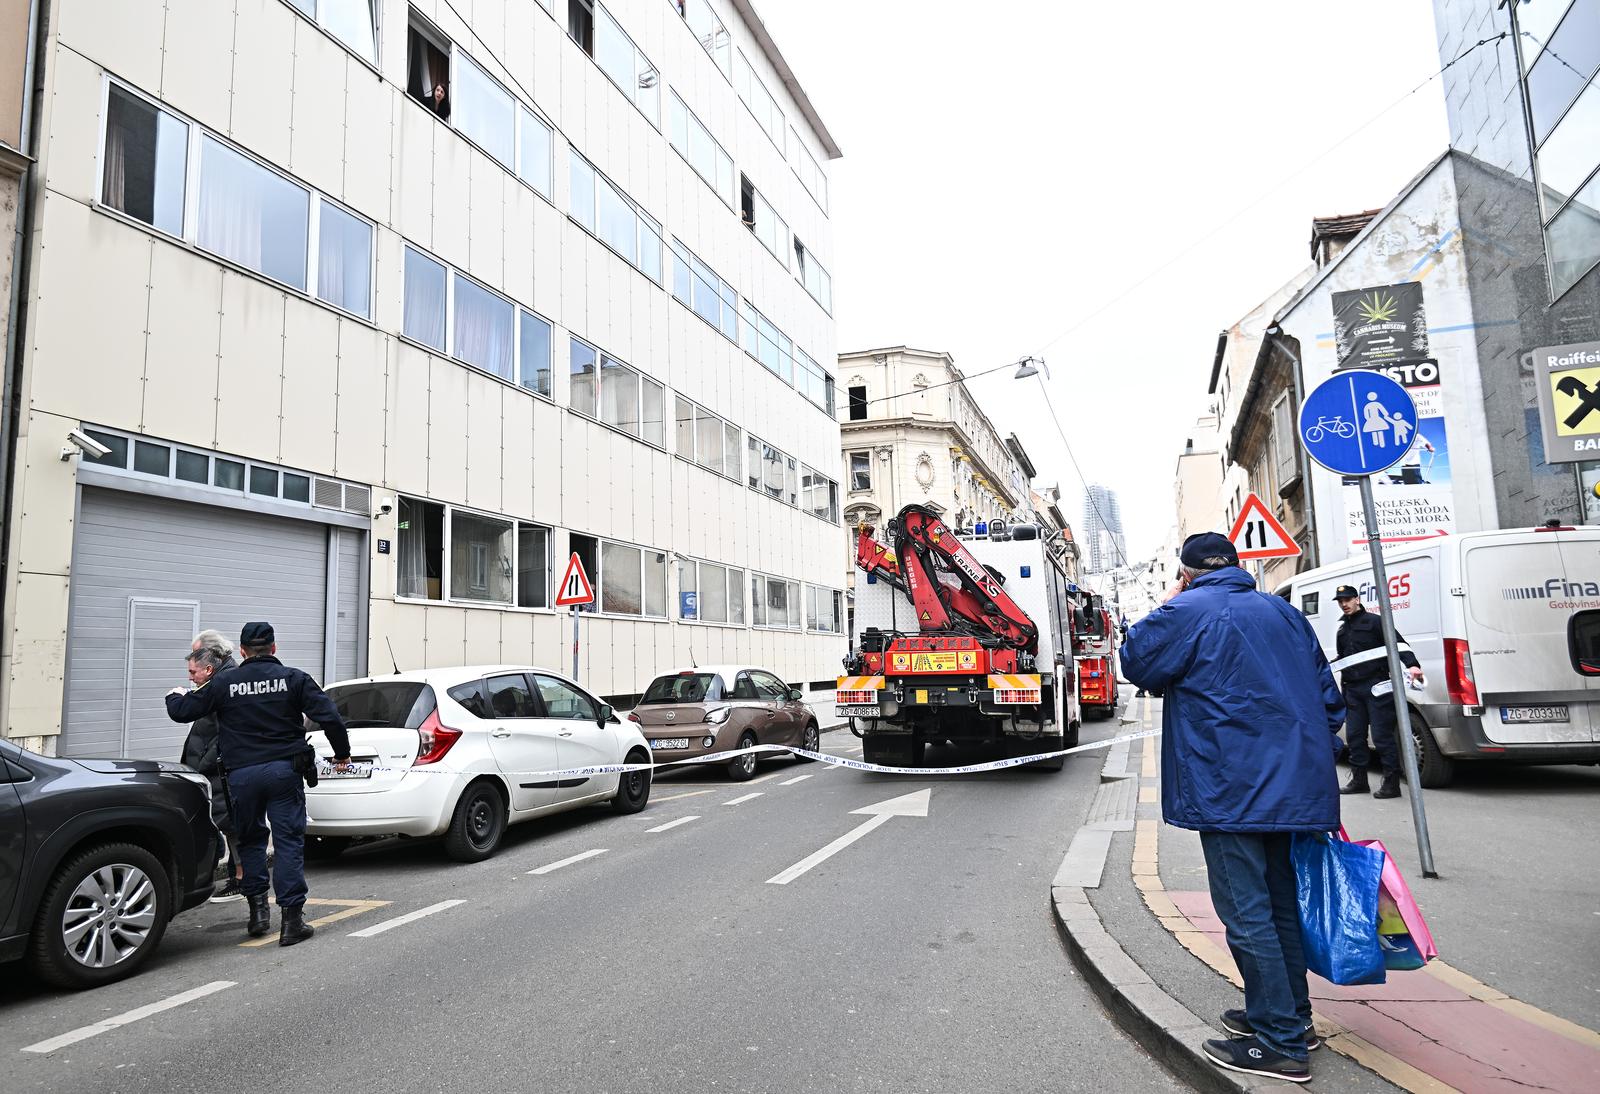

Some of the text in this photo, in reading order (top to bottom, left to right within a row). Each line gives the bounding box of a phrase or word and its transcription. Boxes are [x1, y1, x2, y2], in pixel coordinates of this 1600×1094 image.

[1375, 498, 1430, 509] NGLESKA
[1414, 505, 1449, 514] MODA
[1415, 514, 1451, 523] MORA
[953, 553, 980, 582] KRANE
[229, 678, 288, 698] POLICIJA
[840, 707, 849, 716] ZG
[1508, 708, 1522, 719] ZG
